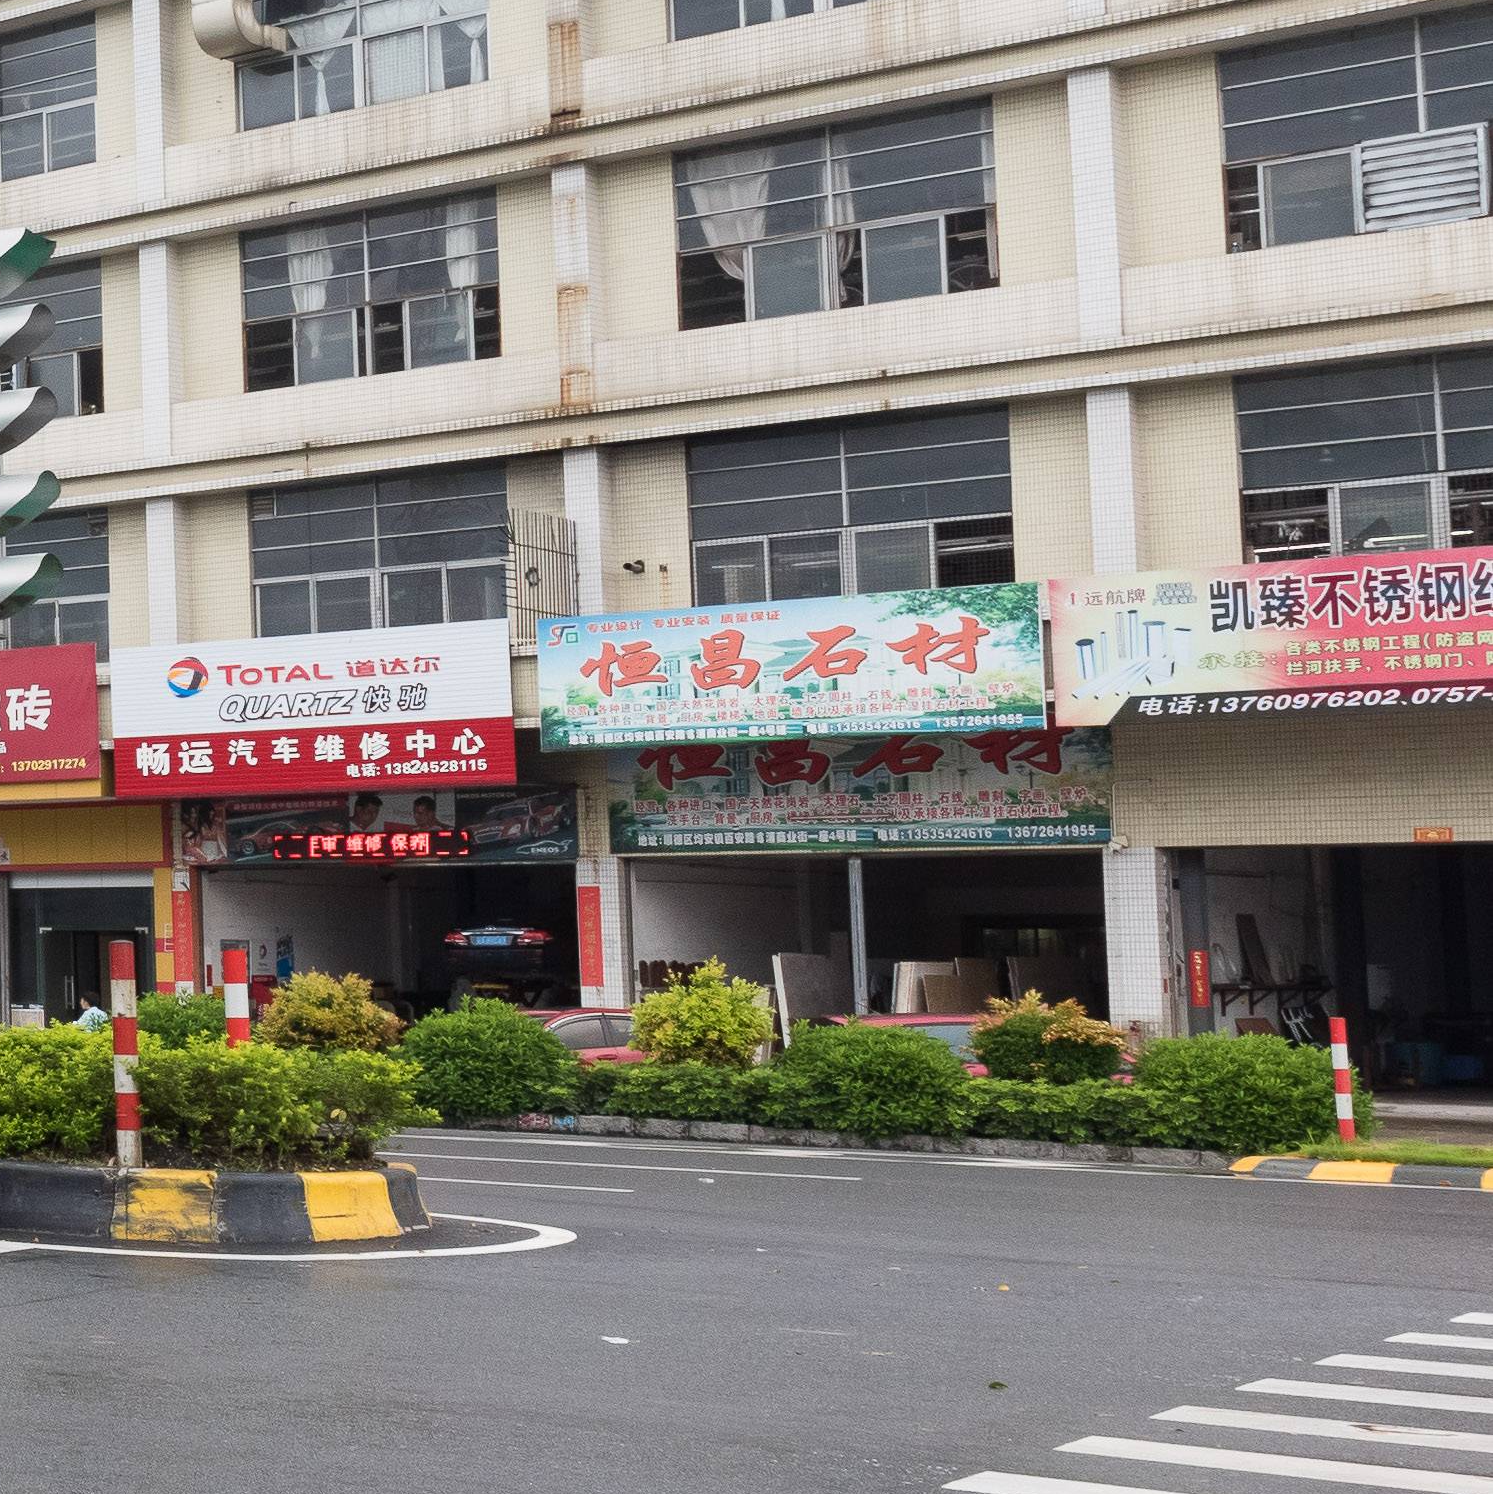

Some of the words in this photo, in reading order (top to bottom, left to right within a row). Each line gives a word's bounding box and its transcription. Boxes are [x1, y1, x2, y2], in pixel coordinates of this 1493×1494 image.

[1084, 587, 1146, 607] 远航牌
[587, 619, 642, 633] 专业设计
[652, 615, 712, 628] 专业安装
[721, 610, 781, 624] 质量保证
[580, 616, 990, 697] 恒昌石材
[217, 663, 333, 686] TOTAL
[346, 656, 440, 679] 道达尔
[219, 689, 357, 722] QUARTZ
[1139, 684, 1493, 716] 电话:13760976202、0757-
[934, 712, 1025, 730] 13672641955
[10, 757, 87, 772] 13702917274
[1006, 824, 1097, 838] 13672641955
[530, 846, 561, 855] ENEOS
